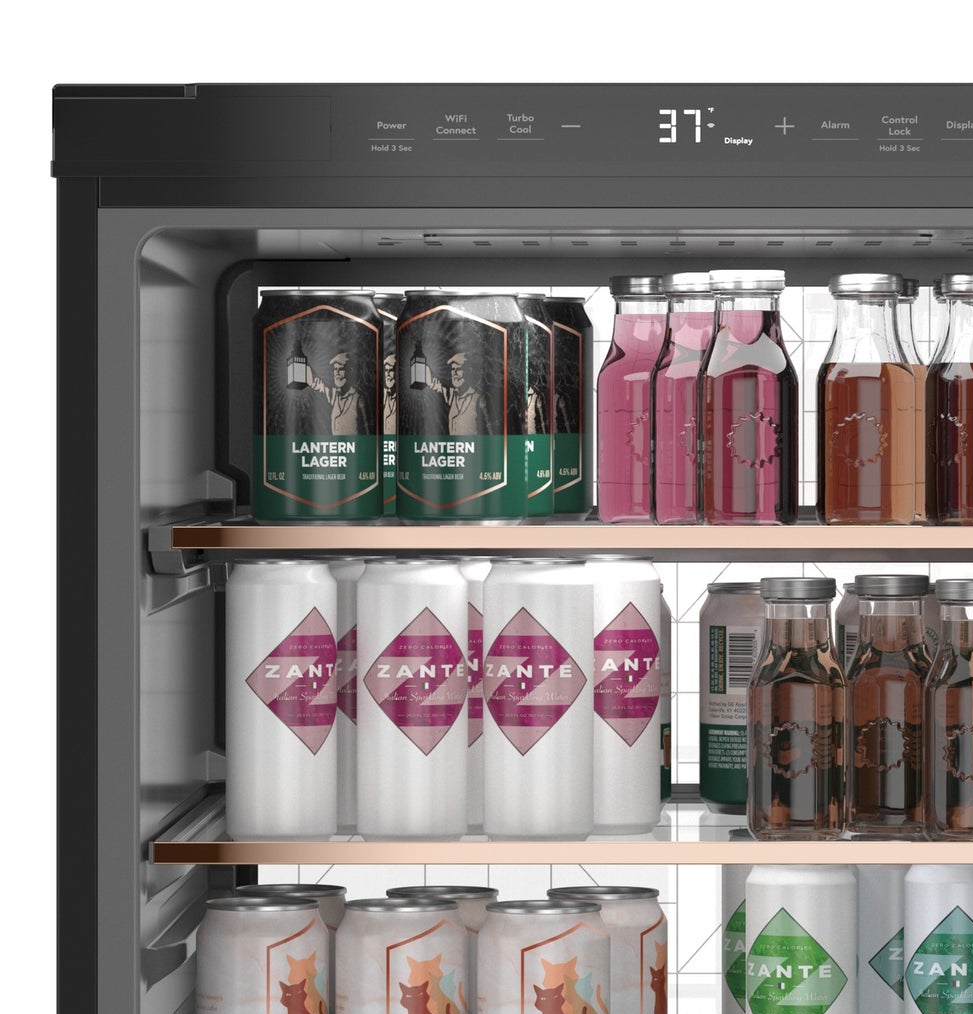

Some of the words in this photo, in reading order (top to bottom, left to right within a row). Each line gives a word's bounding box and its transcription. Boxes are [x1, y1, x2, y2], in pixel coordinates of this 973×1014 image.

[445, 114, 467, 123] WiFi
[507, 114, 534, 123] Turbo
[881, 115, 918, 125] Control
[377, 121, 406, 131] Power
[436, 126, 477, 135] Connect
[509, 125, 532, 134] Cool
[659, 108, 701, 143] 37
[821, 121, 850, 130] Alarm
[888, 127, 911, 136] Lock
[724, 137, 754, 146] Display
[371, 144, 389, 152] Hold
[391, 144, 397, 152] 3
[398, 144, 412, 152] Sec
[879, 144, 897, 152] Hold
[900, 144, 905, 152] 3
[907, 144, 921, 152] Sec
[292, 441, 355, 454] LANTERN
[414, 441, 475, 454] LANTERN
[301, 455, 347, 467] LAGER
[421, 455, 465, 468] LAGER
[593, 657, 660, 671] ANTE
[265, 664, 335, 678] ZANT
[377, 664, 465, 678] ZANTE
[486, 664, 572, 678] ZANTE
[748, 963, 832, 979] ZANTE
